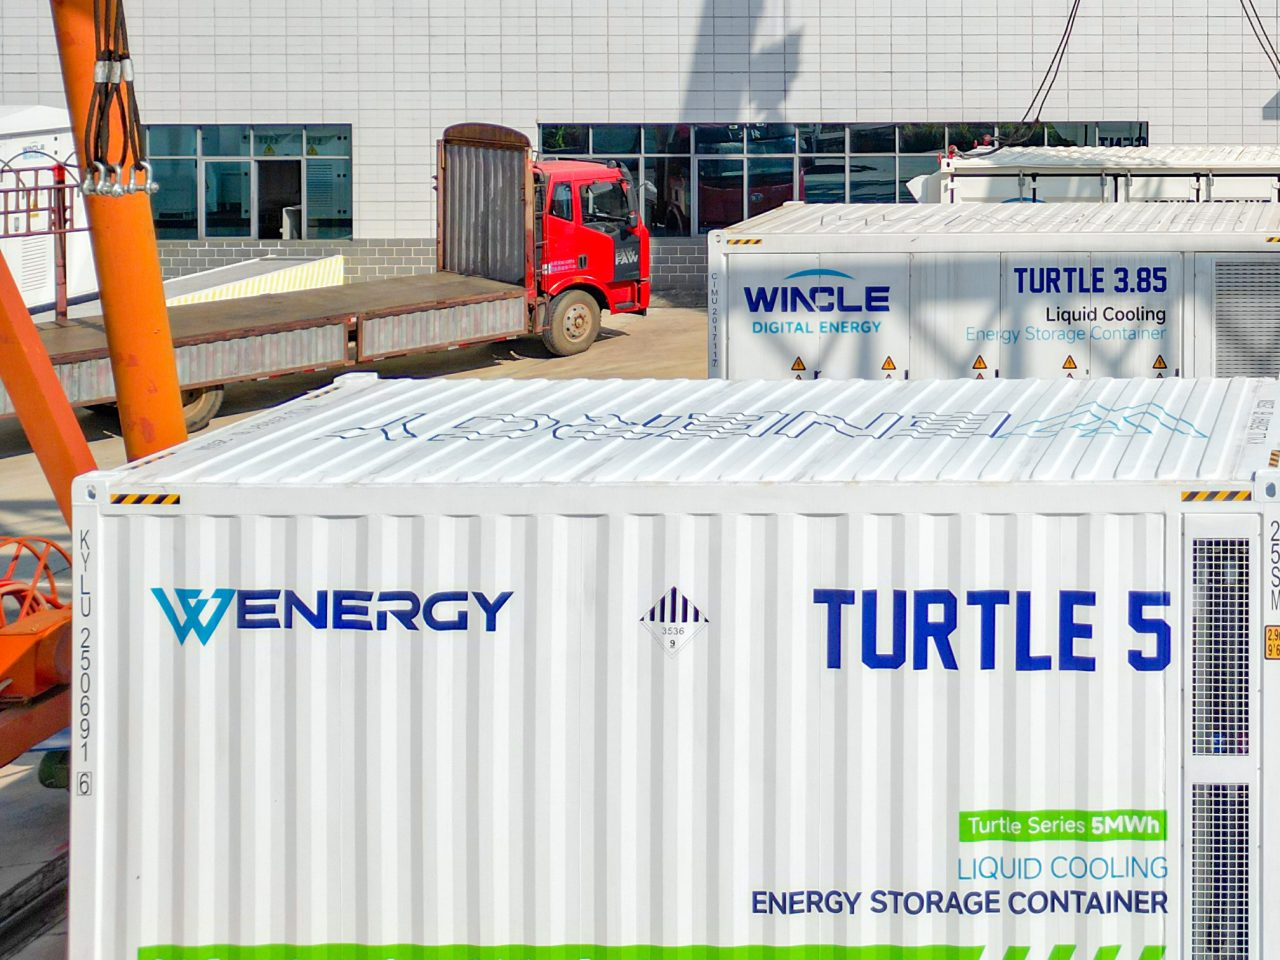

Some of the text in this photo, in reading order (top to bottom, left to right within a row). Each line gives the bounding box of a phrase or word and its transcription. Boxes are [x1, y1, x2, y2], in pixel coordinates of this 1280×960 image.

[615, 248, 638, 265] FAW
[711, 272, 719, 305] CIMU
[1013, 266, 1168, 294] TURTLE 3.85
[743, 286, 890, 313] WINCLE
[752, 320, 882, 334] DIGITAL ENERGY
[1046, 306, 1167, 326] Liquid Cooling
[966, 325, 1167, 344] Energy Storage Container
[661, 626, 685, 636] 3536
[813, 589, 1171, 671] TURTLE 5
[669, 639, 675, 648] 9
[79, 529, 91, 796] KYLU 250691 6
[968, 814, 1160, 834] Turtle Series 5MWh
[958, 855, 1167, 881] LIQUID COOLING
[752, 890, 1167, 914] ENERGY STORAGE CONTAINER
